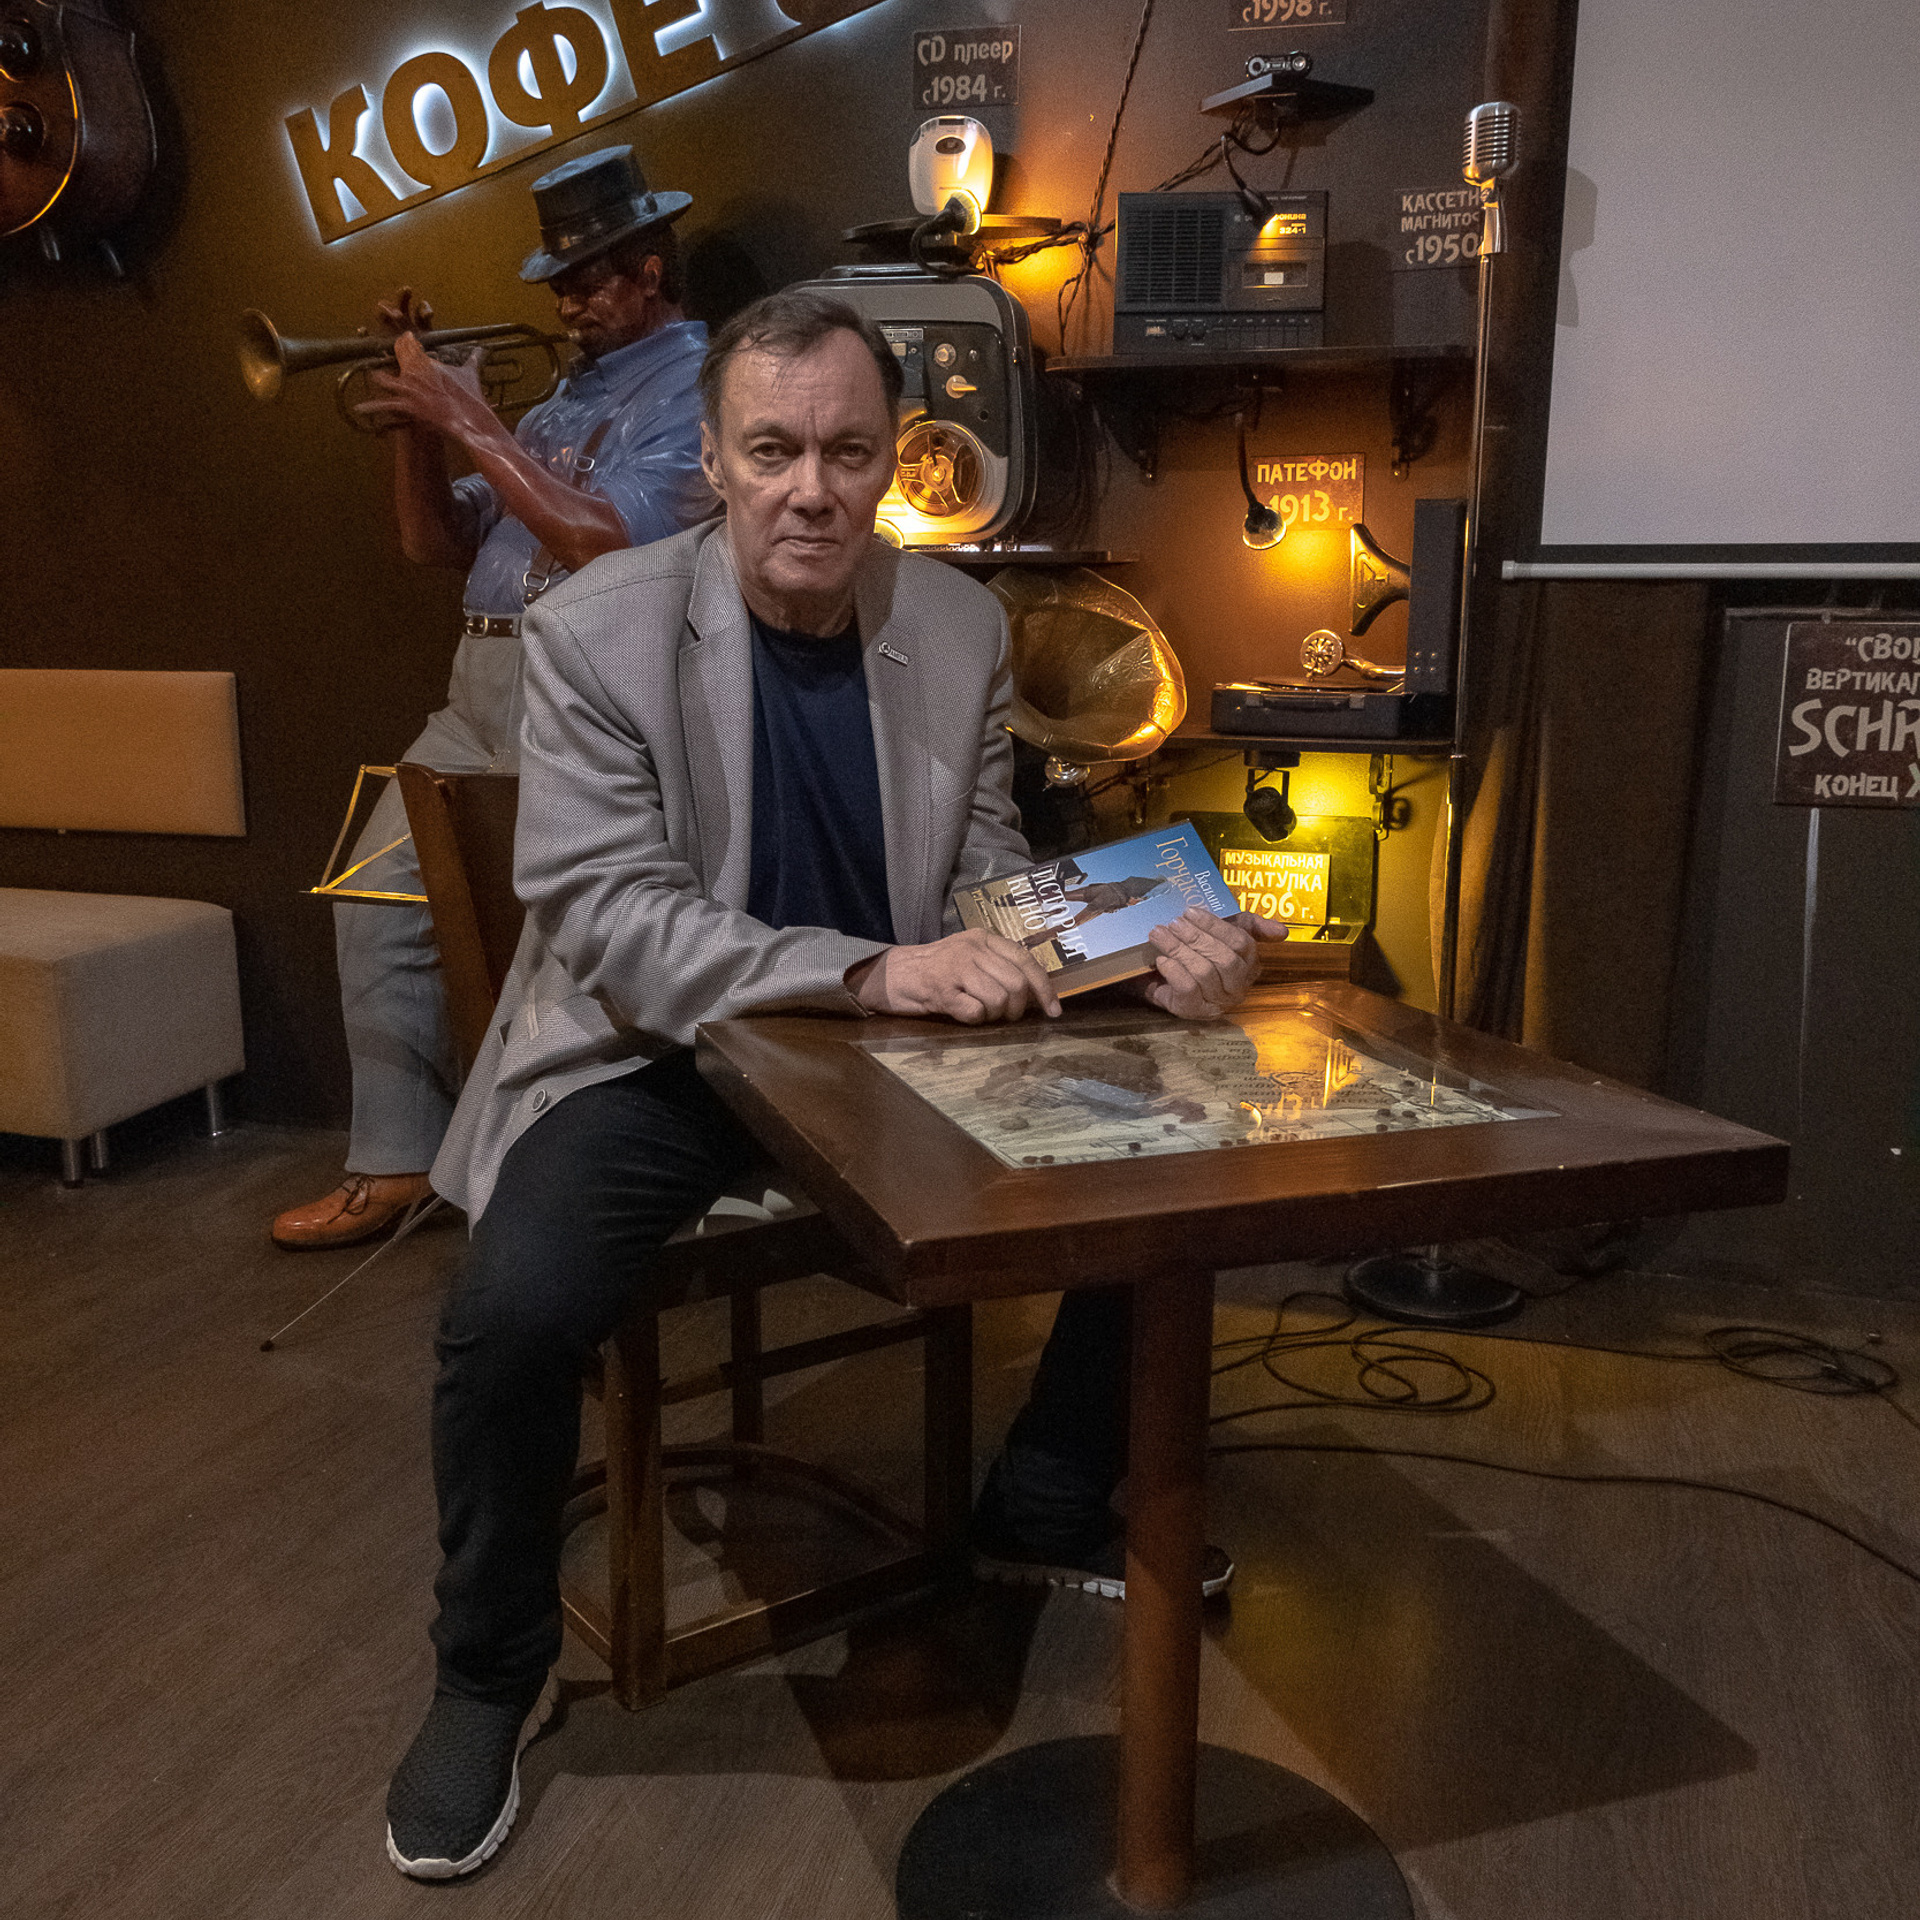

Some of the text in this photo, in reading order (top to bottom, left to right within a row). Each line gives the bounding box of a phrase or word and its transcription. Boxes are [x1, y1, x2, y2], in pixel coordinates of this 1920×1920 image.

[954, 41, 1014, 65] плеер
[994, 85, 1006, 98] г.
[1257, 458, 1357, 485] ПАТЕФОН
[1269, 490, 1353, 527] 1913 г.
[1814, 772, 1899, 801] КОНЕЦ
[1225, 851, 1324, 870] МУЗЫКАЛЬНАЯ
[1194, 870, 1226, 912] Василий
[1223, 869, 1323, 893] ШКАТУЛКА
[1007, 876, 1047, 930] КИНО
[1030, 866, 1089, 959] ИСТОРИЯ
[1238, 891, 1314, 919] 1796 г.
